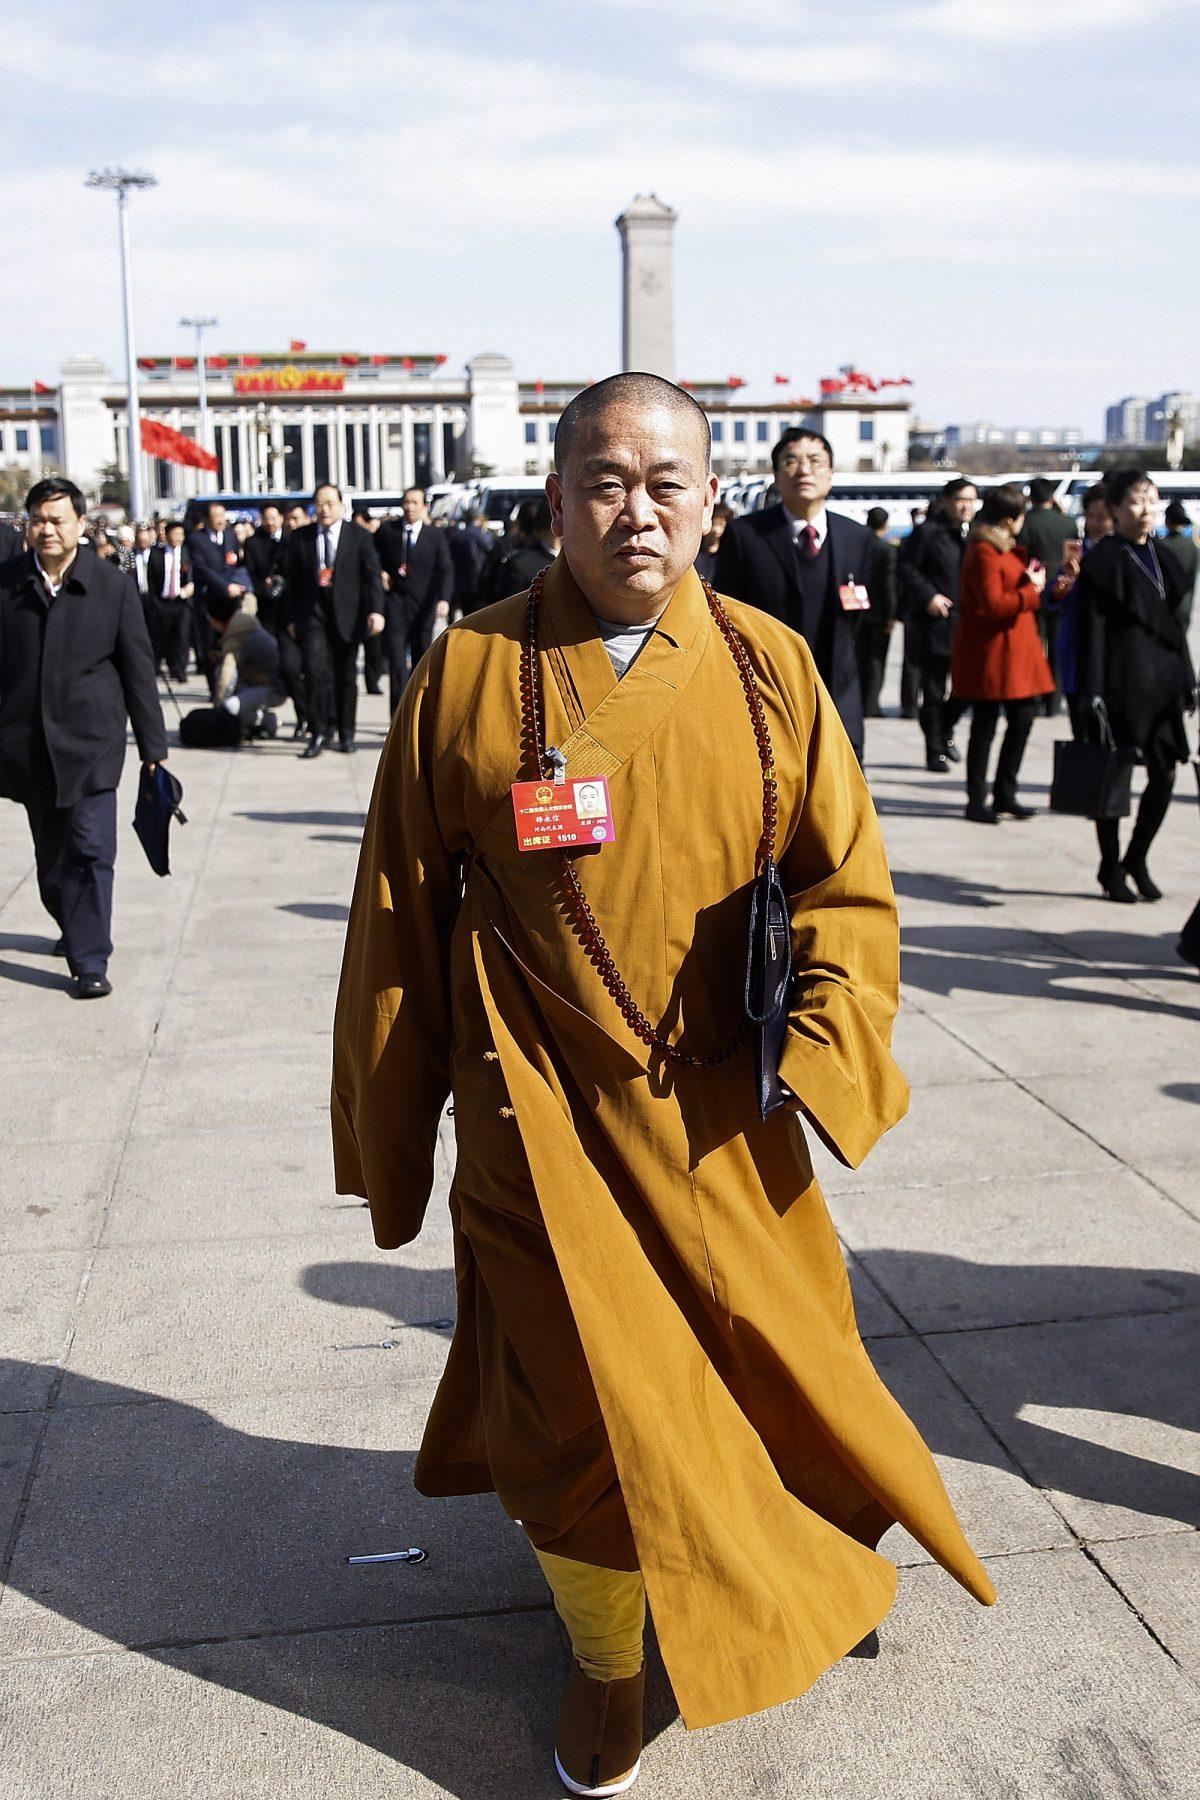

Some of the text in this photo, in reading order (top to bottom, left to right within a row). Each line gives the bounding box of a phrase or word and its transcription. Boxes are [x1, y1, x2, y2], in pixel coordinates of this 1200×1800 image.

[523, 833, 577, 846] 出席证 1510
